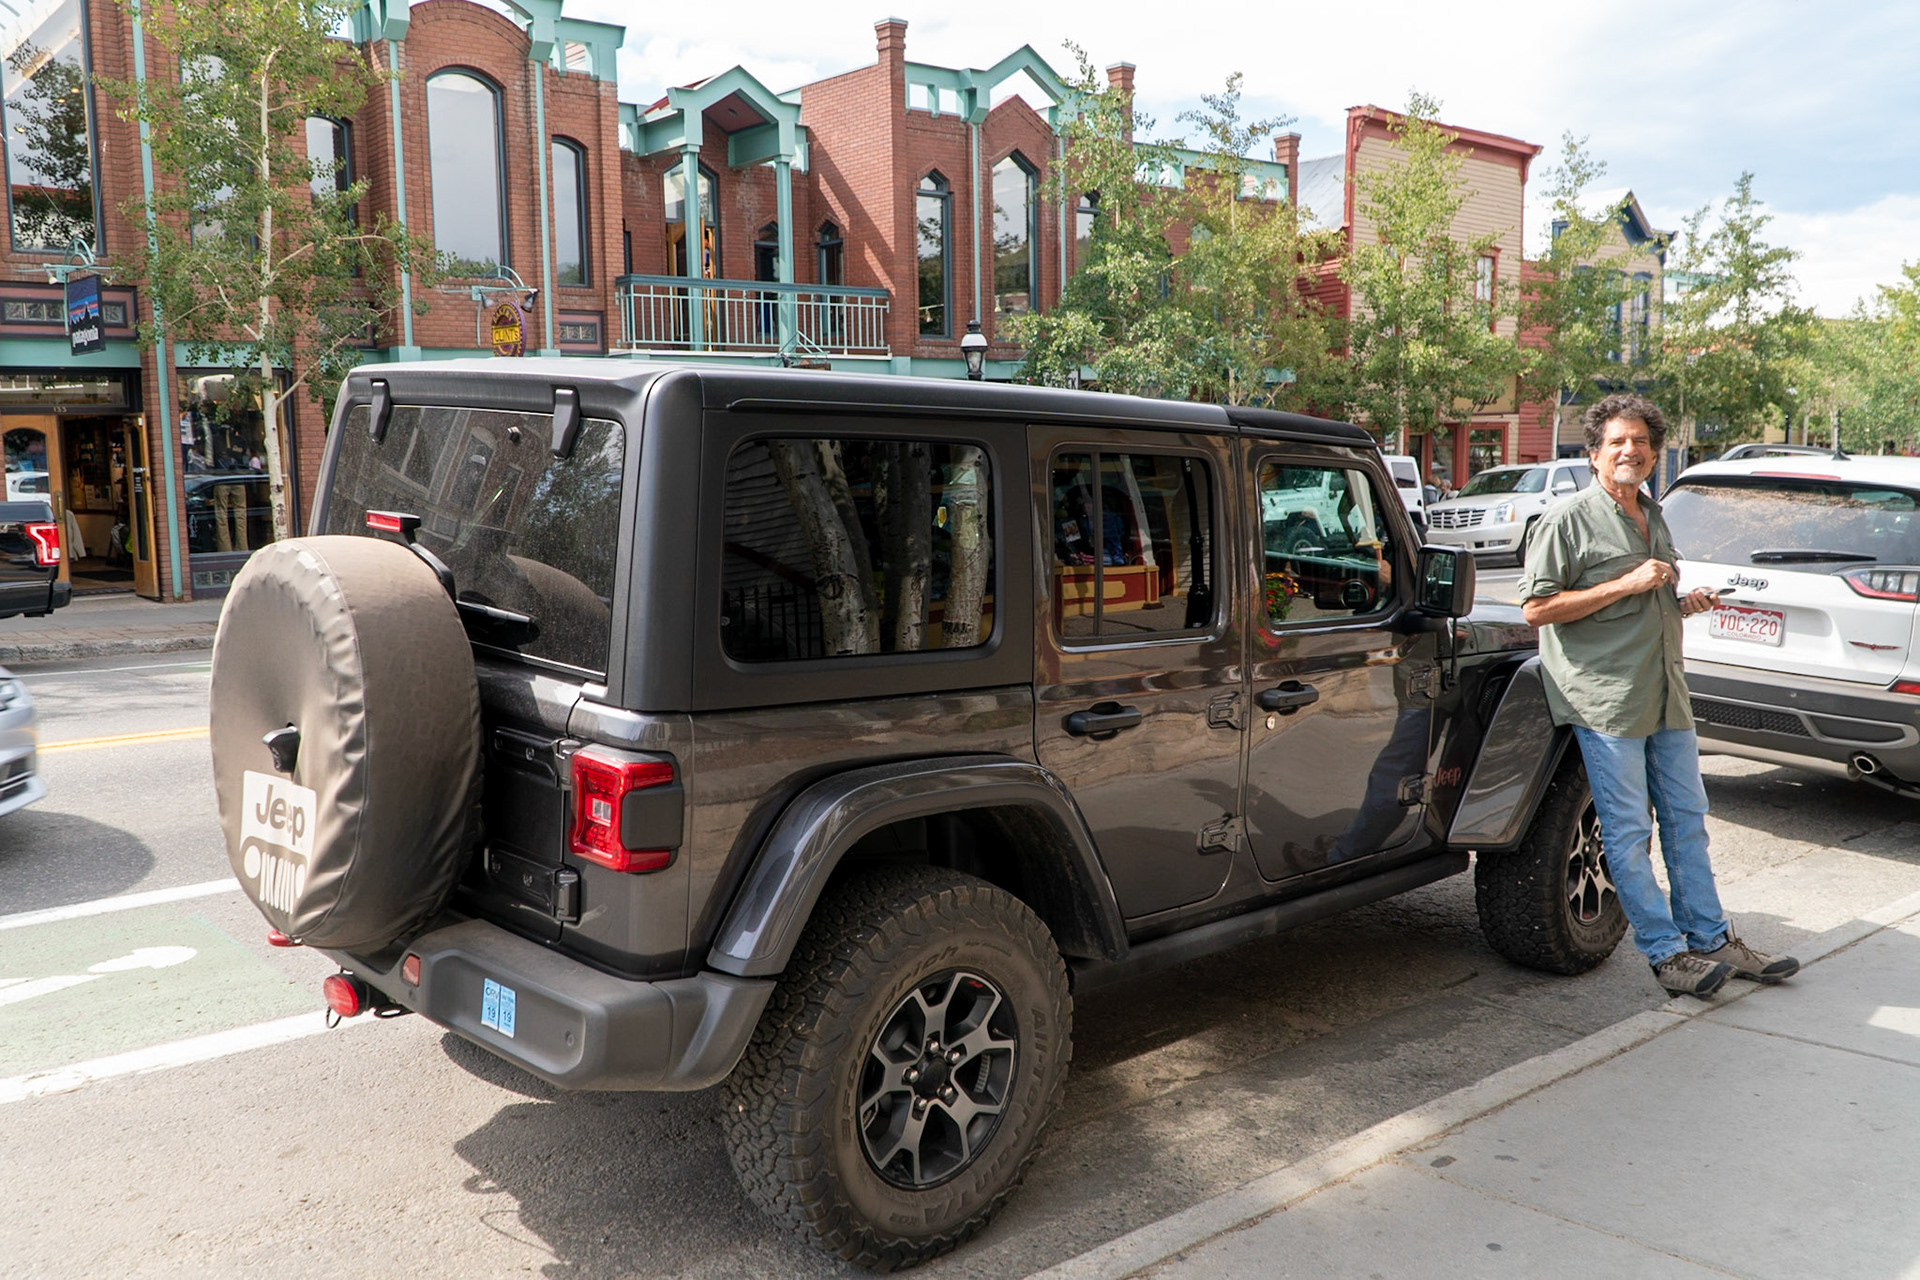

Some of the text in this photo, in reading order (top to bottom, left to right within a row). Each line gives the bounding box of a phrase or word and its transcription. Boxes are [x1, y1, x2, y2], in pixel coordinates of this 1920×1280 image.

[72, 325, 99, 348] patagonia
[1727, 573, 1769, 591] Jeep
[1726, 631, 1762, 641] COLORADO
[1433, 767, 1461, 787] Jeep
[256, 784, 305, 845] Jeep
[487, 1006, 496, 1019] 19
[502, 1010, 512, 1023] 19
